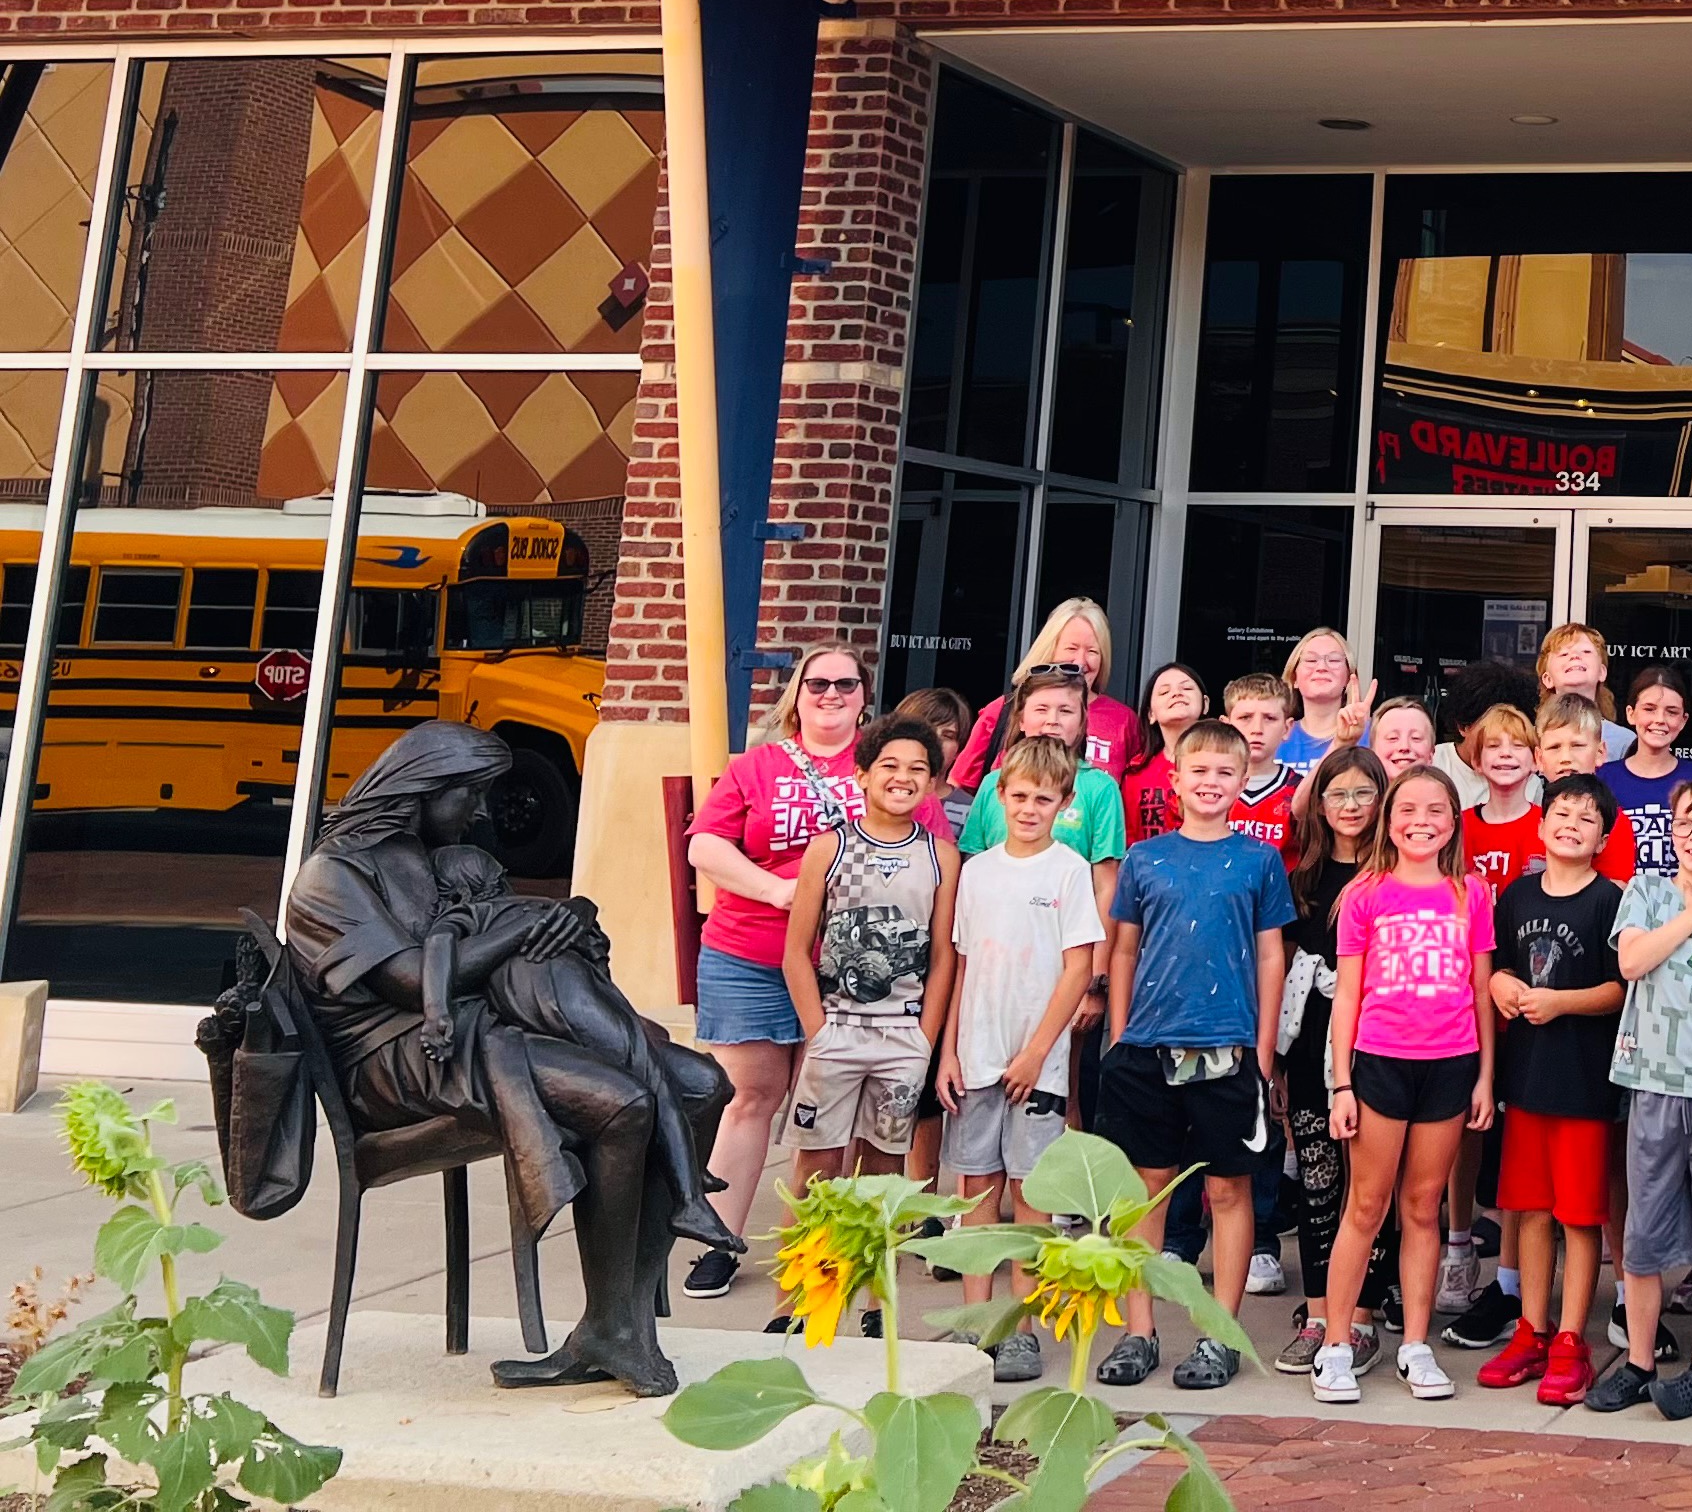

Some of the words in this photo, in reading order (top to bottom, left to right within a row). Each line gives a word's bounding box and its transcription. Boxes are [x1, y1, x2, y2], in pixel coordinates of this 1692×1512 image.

[1555, 471, 1601, 492] 334
[890, 634, 908, 648] BUY
[908, 635, 924, 649] ICT
[924, 636, 941, 649] ART
[941, 636, 948, 650] &
[948, 637, 972, 650] GIFTS
[1606, 645, 1628, 657] UY
[1630, 645, 1657, 658] ICT
[1659, 646, 1692, 659] ART
[1516, 917, 1553, 942] HILL
[1556, 923, 1586, 958] OUT
